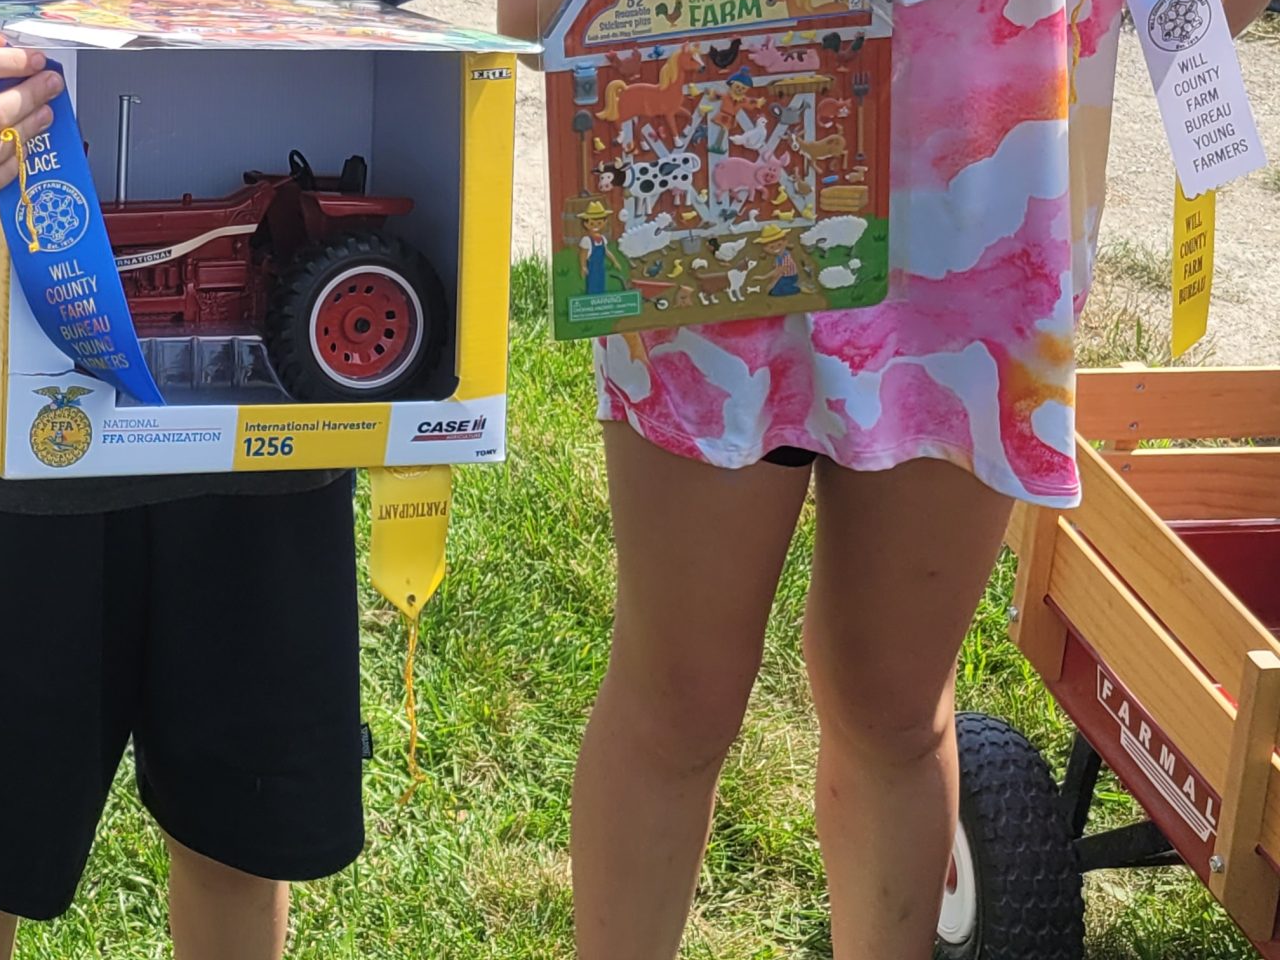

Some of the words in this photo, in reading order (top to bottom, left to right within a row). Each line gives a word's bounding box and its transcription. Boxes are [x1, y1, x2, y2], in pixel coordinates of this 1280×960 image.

[471, 68, 512, 80] ERTL
[1177, 53, 1208, 74] WILL
[1174, 65, 1220, 97] COUNTY
[1186, 87, 1219, 112] FARM
[1184, 102, 1232, 134] BUREAU
[27, 133, 52, 155] RST
[1193, 123, 1235, 151] YOUNG
[25, 152, 61, 175] LACE
[1193, 139, 1249, 173] FARMERS
[1185, 210, 1202, 234] WILL
[1180, 230, 1207, 259] COUNTY
[117, 250, 171, 267] RNATIONAL
[1183, 255, 1203, 280] FARM
[48, 259, 85, 281] WILL
[46, 275, 97, 304] COUNTY
[1178, 276, 1206, 305] BUREAU
[59, 297, 97, 321] FARM
[60, 315, 111, 340] BUREAU
[71, 336, 115, 356] YOUNG
[51, 421, 74, 431] FFA
[103, 419, 159, 429] NATIONAL
[245, 421, 319, 432] International
[417, 420, 471, 433] CASE
[102, 433, 125, 443] FFA
[127, 432, 221, 443] ORGANIZATION
[243, 437, 294, 457] 1256
[475, 448, 497, 457] TOMY
[378, 501, 447, 520] PARTICIPANT
[1102, 679, 1216, 826] FARMAL
